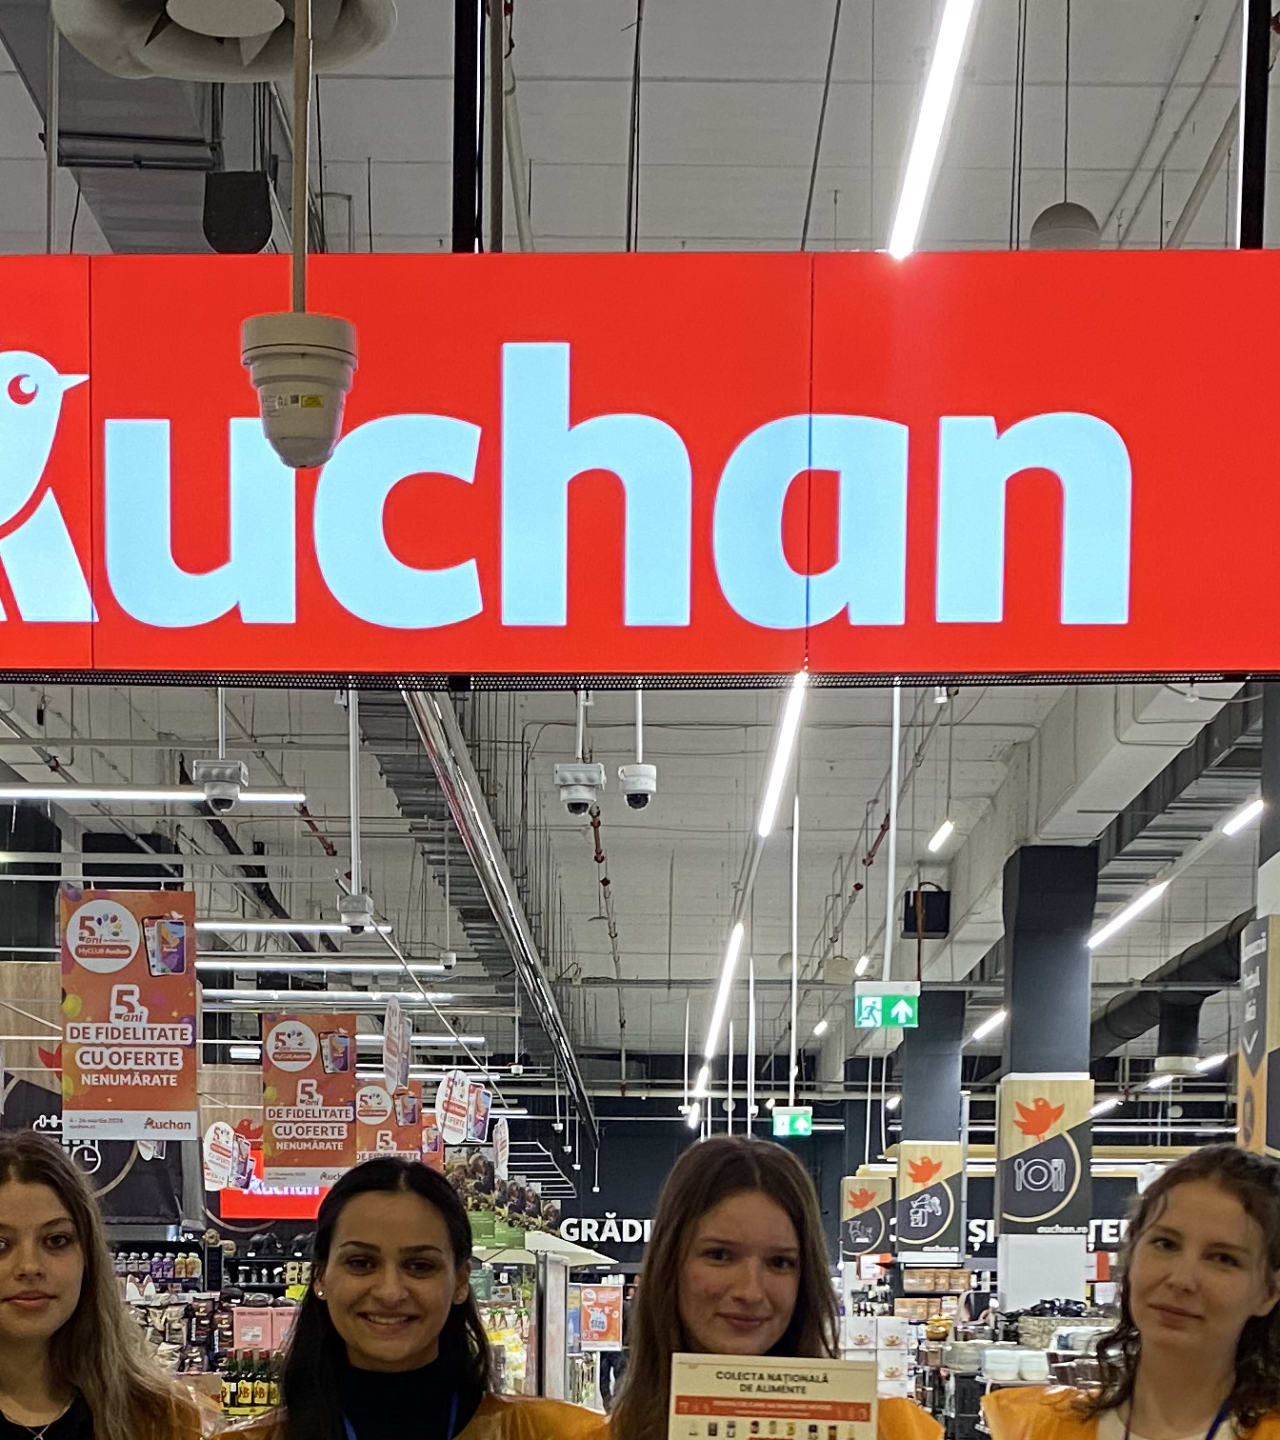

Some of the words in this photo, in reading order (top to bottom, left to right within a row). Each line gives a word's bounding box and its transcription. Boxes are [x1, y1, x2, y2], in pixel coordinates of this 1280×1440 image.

[79, 916, 95, 941] 5
[115, 989, 135, 1019] 5
[122, 1011, 144, 1023] ani
[70, 1026, 91, 1040] DE
[96, 1026, 189, 1041] FIDELITATE
[79, 1051, 104, 1066] CU
[109, 1051, 180, 1067] OFERTE
[81, 1071, 178, 1086] NENUMĂRATE
[269, 1109, 283, 1118] DE
[286, 1108, 351, 1119] FIDELITATE
[144, 1117, 191, 1131] Auchan
[275, 1126, 291, 1136] CU
[296, 1126, 345, 1137] OFERTE
[276, 1141, 344, 1150] NENUMĂRATE
[560, 1212, 650, 1243] GRĂDI
[715, 1371, 765, 1382] COLECTA
[767, 1372, 829, 1385] NAȚIONALĂ
[740, 1384, 754, 1393] DE
[755, 1385, 807, 1395] ALIMENTE
